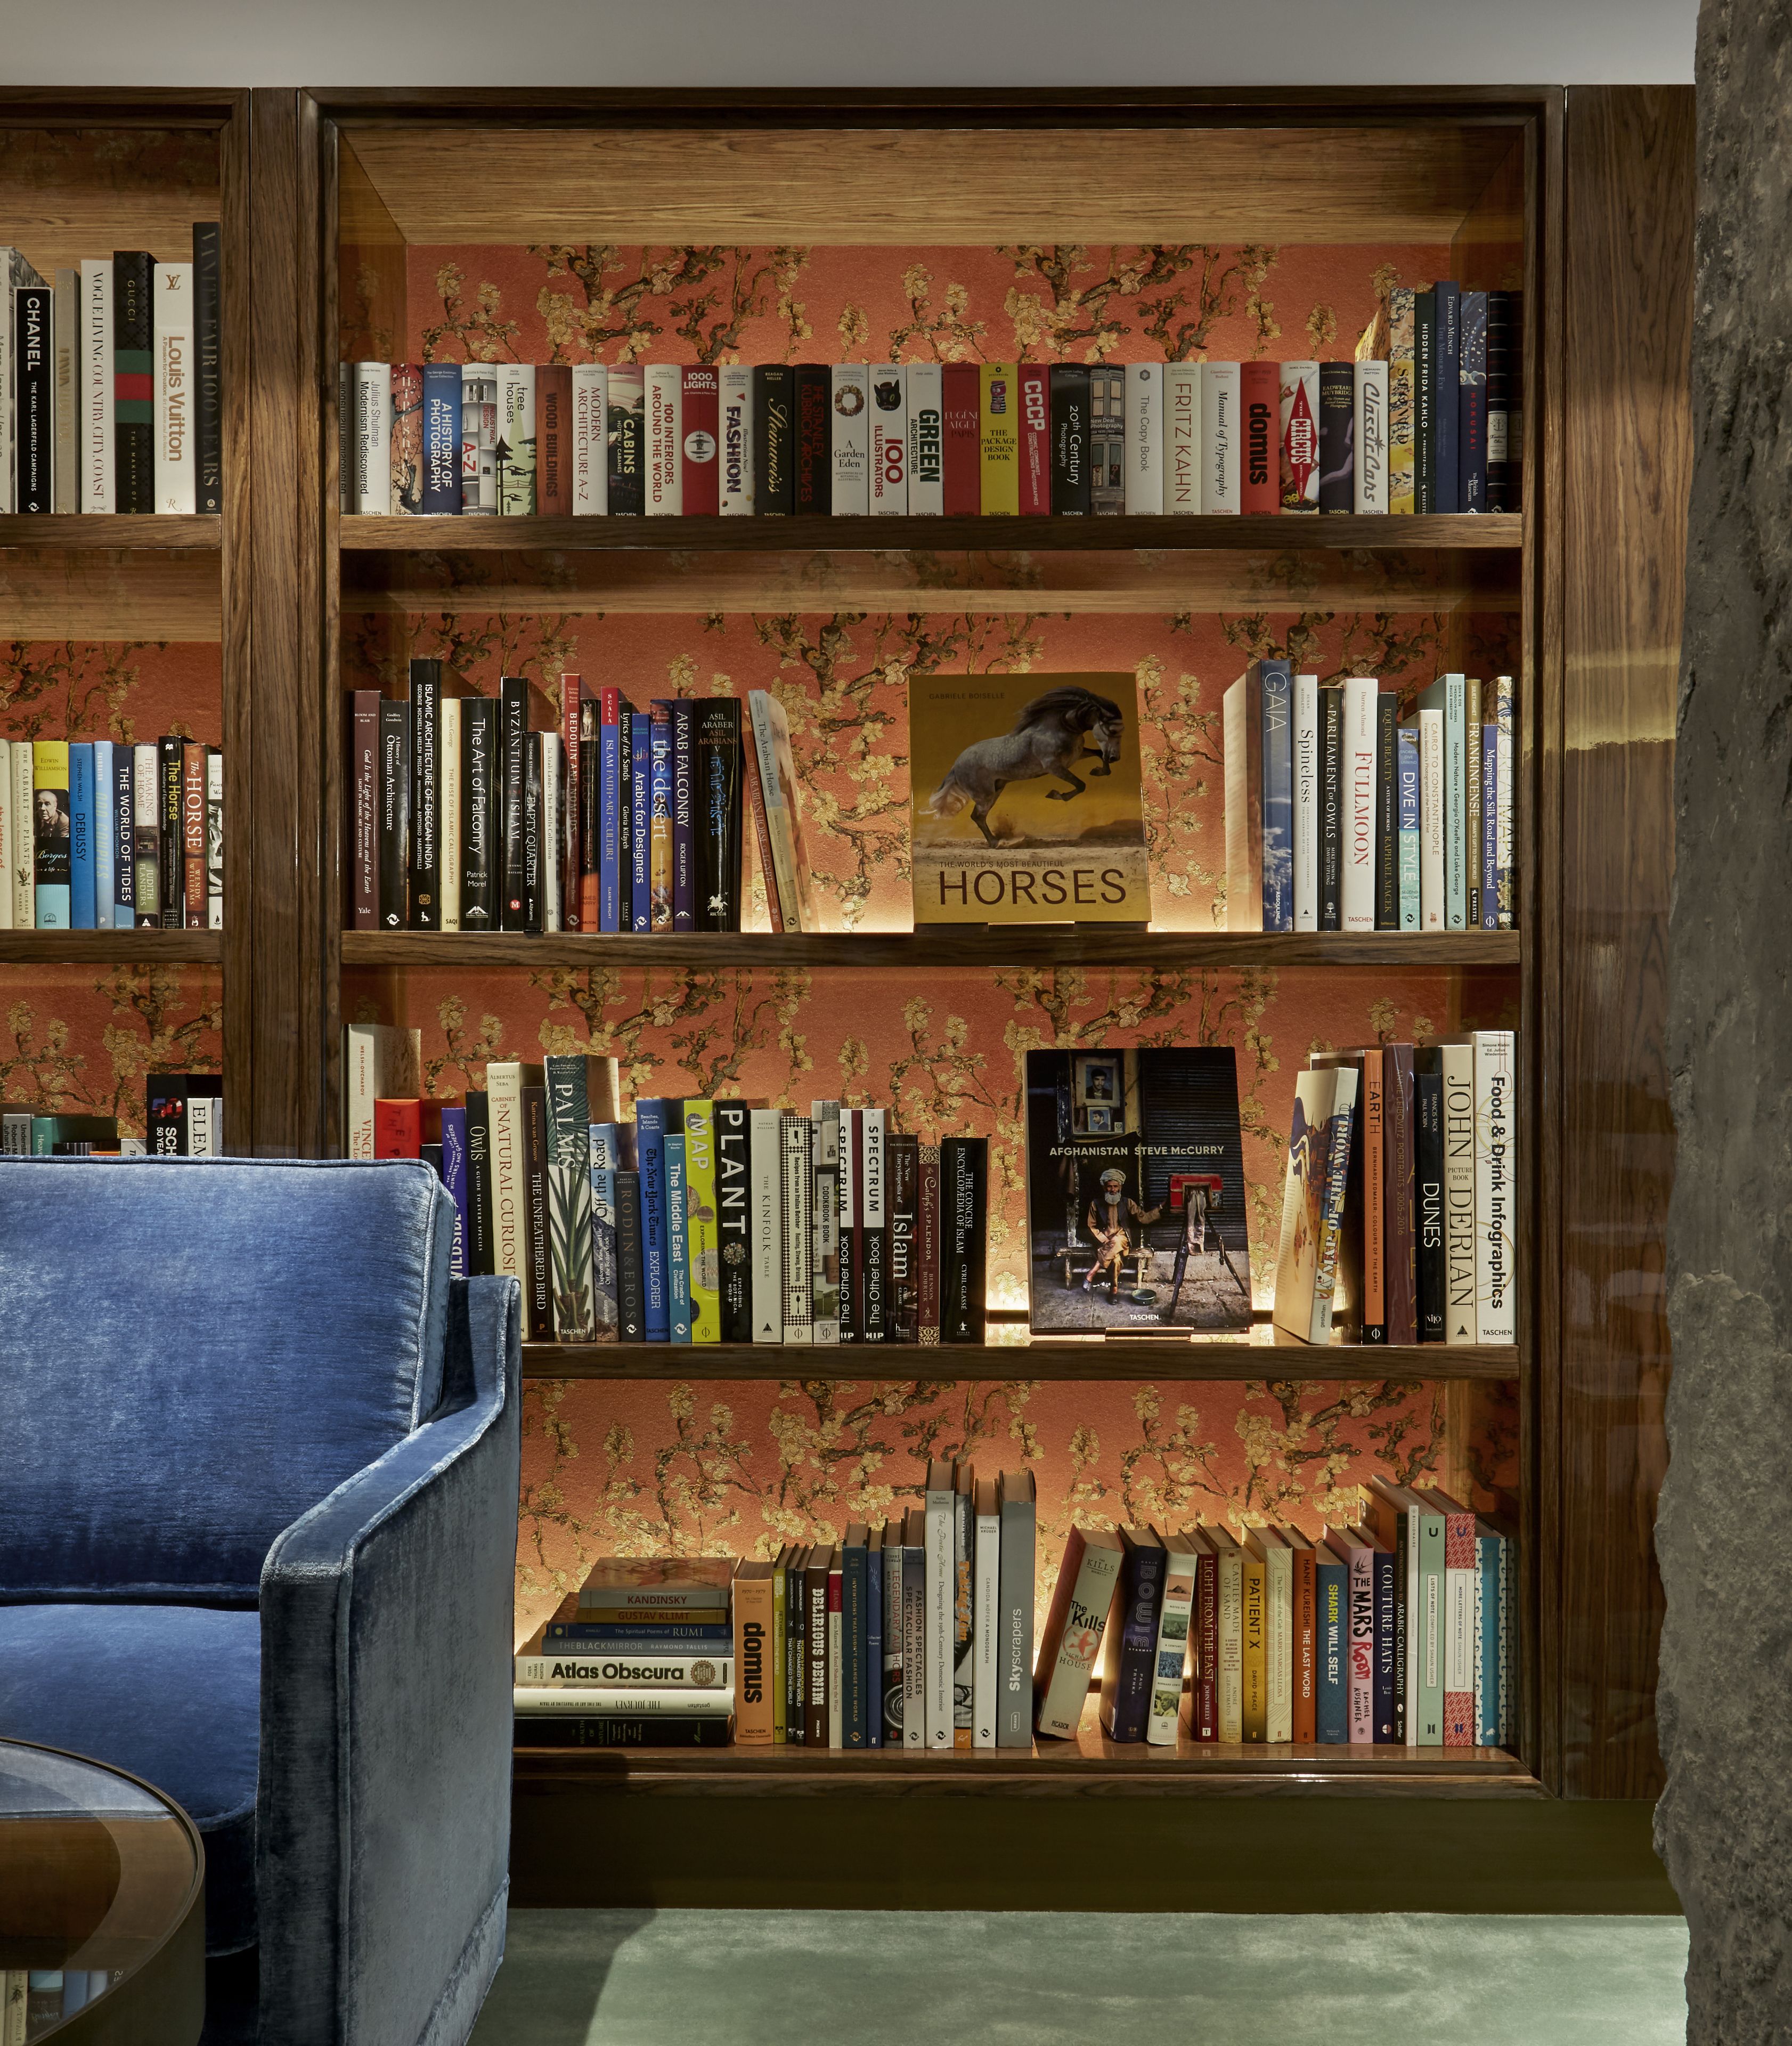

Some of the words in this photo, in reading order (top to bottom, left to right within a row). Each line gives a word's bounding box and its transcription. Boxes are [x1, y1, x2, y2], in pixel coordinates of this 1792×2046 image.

[92, 272, 103, 314] VOGUE
[27, 297, 40, 371] CHANEL
[93, 317, 103, 361] LIVING
[168, 336, 185, 388] Louis
[93, 364, 103, 425] COUNTRY,
[360, 381, 369, 432] Modernism
[442, 403, 452, 412] A
[507, 382, 520, 424] houses
[517, 387, 528, 411] tree
[545, 392, 558, 429] WOOD
[1024, 380, 1045, 431] CCCP
[1175, 384, 1191, 439] FRITZ
[93, 426, 103, 458] CITY,
[168, 392, 185, 461] Vuitton
[429, 399, 442, 492] PHOTOGRAPHY
[442, 414, 452, 468] HISTORY
[623, 419, 635, 474] CABINS
[919, 409, 940, 483] GREEN
[1059, 423, 1068, 467] Photography
[1249, 403, 1271, 485] domus
[1291, 418, 1313, 466] CIRCUS
[360, 434, 369, 495] Rediscovered
[545, 434, 558, 498] BUILDINGS
[726, 406, 743, 493] FASHION
[1066, 434, 1081, 485] Century
[93, 459, 104, 499] COAST
[442, 470, 452, 488] OF
[1175, 445, 1191, 501] KAHN
[425, 684, 433, 718] ISLAMIC
[1263, 672, 1287, 734] GAIA
[472, 718, 485, 745] The
[677, 712, 688, 750] ARAB
[168, 760, 181, 782] The
[191, 761, 199, 776] The
[386, 735, 395, 775] Ottoman
[425, 720, 433, 785] ARCHITECTURE
[472, 749, 485, 773] Art
[1300, 730, 1314, 802] Spineless
[1468, 721, 1481, 818] FRANKINCENSE
[119, 766, 129, 790] THE
[425, 789, 433, 799] OF
[472, 778, 485, 794] of
[635, 771, 646, 808] Arabic
[677, 756, 688, 827] FALCONRY
[1403, 772, 1415, 808] DIVE
[120, 795, 130, 840] WORLD
[169, 785, 181, 822] Horse
[187, 777, 202, 848] HORSE
[386, 776, 395, 831] Architecture
[425, 802, 433, 841] DECCAN
[636, 809, 646, 826] for
[1354, 752, 1372, 866] FULLMOON
[1403, 814, 1416, 831] IN
[76, 813, 86, 861] DEBUSSY
[468, 797, 486, 856] Falconry
[37, 850, 67, 864] Borges
[121, 845, 131, 862] OF
[425, 843, 433, 870] INDIA
[635, 829, 646, 883] Designers
[1404, 835, 1416, 881] STYLE
[121, 866, 131, 901] TIDES
[939, 868, 1126, 905] HORSES
[1348, 915, 1375, 924] TASCHEN
[1369, 1082, 1380, 1134] EARTH
[1448, 1076, 1471, 1159] JOHN
[1491, 1077, 1505, 1119] Food
[470, 1126, 486, 1160] Owls
[555, 1083, 577, 1171] PALMS
[690, 1116, 710, 1170] MAP
[1492, 1128, 1505, 1138] &
[592, 1139, 606, 1170] Road
[868, 1126, 879, 1211] SPECTRUM
[1049, 1147, 1128, 1157] AFGHANISTAN
[1135, 1146, 1168, 1157] STEVE
[1171, 1146, 1224, 1155] McCURRY
[1491, 1144, 1506, 1191] Drink
[594, 1174, 606, 1189] the
[670, 1163, 681, 1187] The
[720, 1110, 746, 1235] PLANT
[593, 1189, 608, 1220] Off
[671, 1190, 682, 1231] Middle
[762, 1195, 771, 1251] KINFOLK
[1423, 1183, 1440, 1247] DUNES
[672, 1235, 683, 1262] East
[869, 1236, 879, 1264] Book
[893, 1212, 913, 1279] Islam
[1449, 1187, 1473, 1308] DERIAN
[1489, 1197, 1506, 1309] Infographics
[869, 1268, 879, 1301] Other
[870, 1304, 879, 1325] The
[1129, 1313, 1161, 1322] TASCHEN
[628, 1596, 687, 1604] KANDINSKY
[1353, 1577, 1370, 1587] THE
[1382, 1565, 1392, 1632] COUTURE
[617, 1611, 656, 1620] GUSTAV
[658, 1611, 690, 1620] KLIMT
[1070, 1601, 1087, 1613] The
[1071, 1610, 1105, 1632] Kills
[1249, 1578, 1260, 1635] PATIENT
[1329, 1584, 1339, 1625] SHARK
[1353, 1589, 1373, 1638] MARS
[673, 1628, 702, 1636] RUMI
[1249, 1640, 1260, 1649] X
[1328, 1625, 1338, 1654] WILL
[551, 1662, 599, 1680] Atlas
[602, 1663, 684, 1680] Obscura
[743, 1622, 766, 1704] domus
[1328, 1657, 1338, 1685] SELF
[1382, 1638, 1392, 1673] HATS
